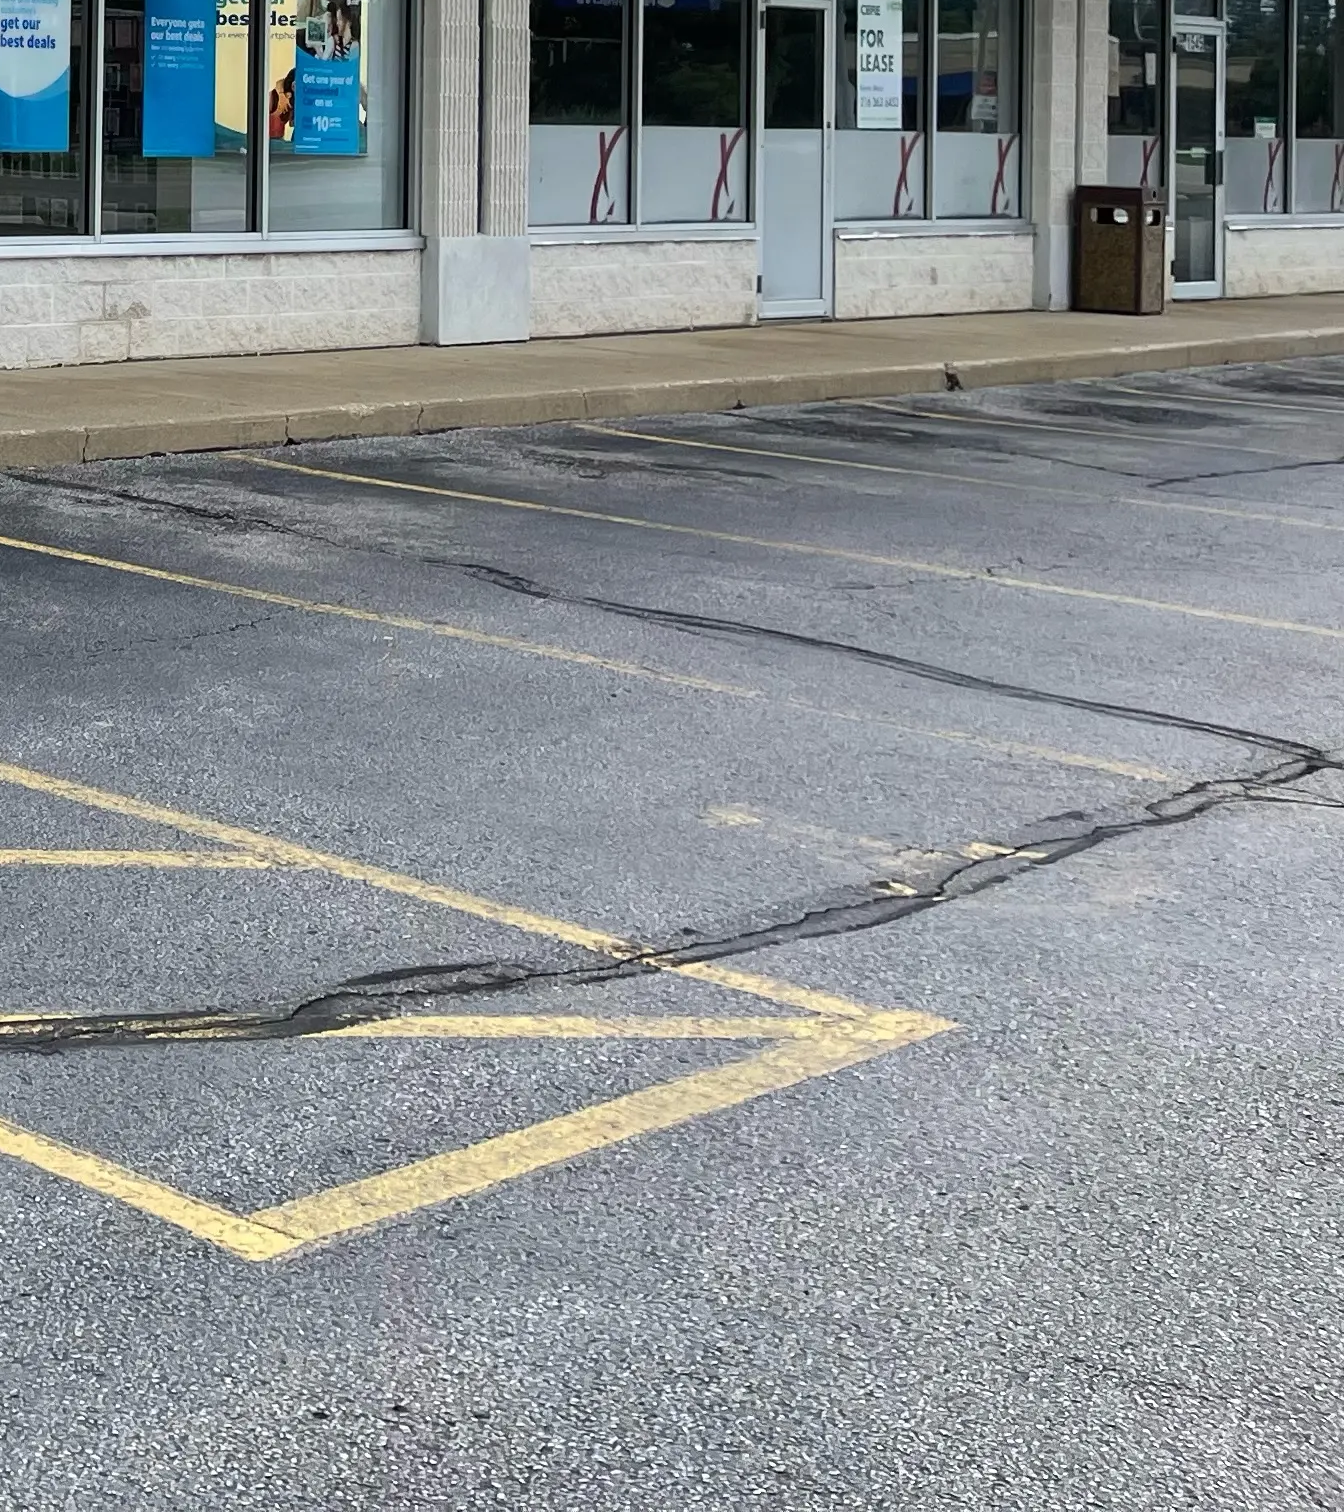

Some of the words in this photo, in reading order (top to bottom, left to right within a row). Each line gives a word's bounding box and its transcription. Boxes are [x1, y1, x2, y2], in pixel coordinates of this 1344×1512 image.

[0, 17, 19, 32] get
[22, 19, 41, 30] our
[0, 34, 24, 48] best
[27, 34, 56, 49] deals
[860, 29, 884, 48] FOR
[860, 54, 894, 73] LEASE
